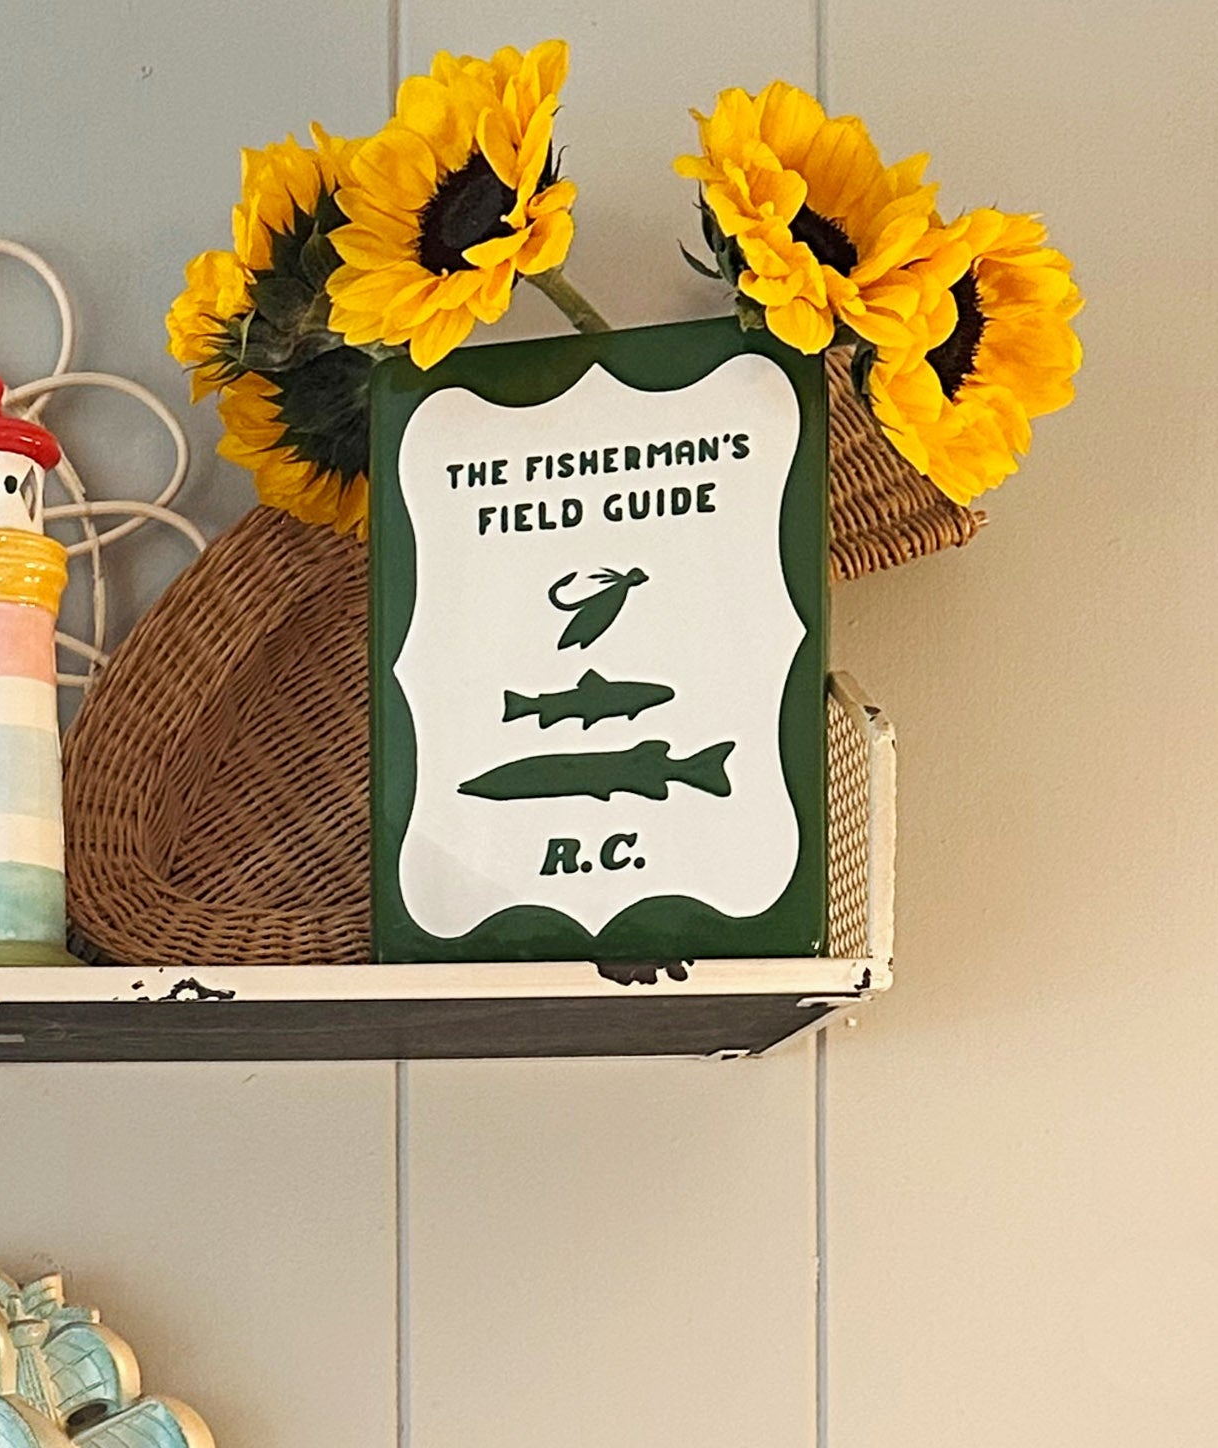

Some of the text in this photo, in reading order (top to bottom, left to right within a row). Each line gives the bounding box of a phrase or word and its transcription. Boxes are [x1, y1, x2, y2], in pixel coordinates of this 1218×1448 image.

[447, 433, 750, 489] THE FISHERMAN'S
[479, 483, 717, 535] FIELD GUIDE
[539, 833, 646, 875] R.C.
